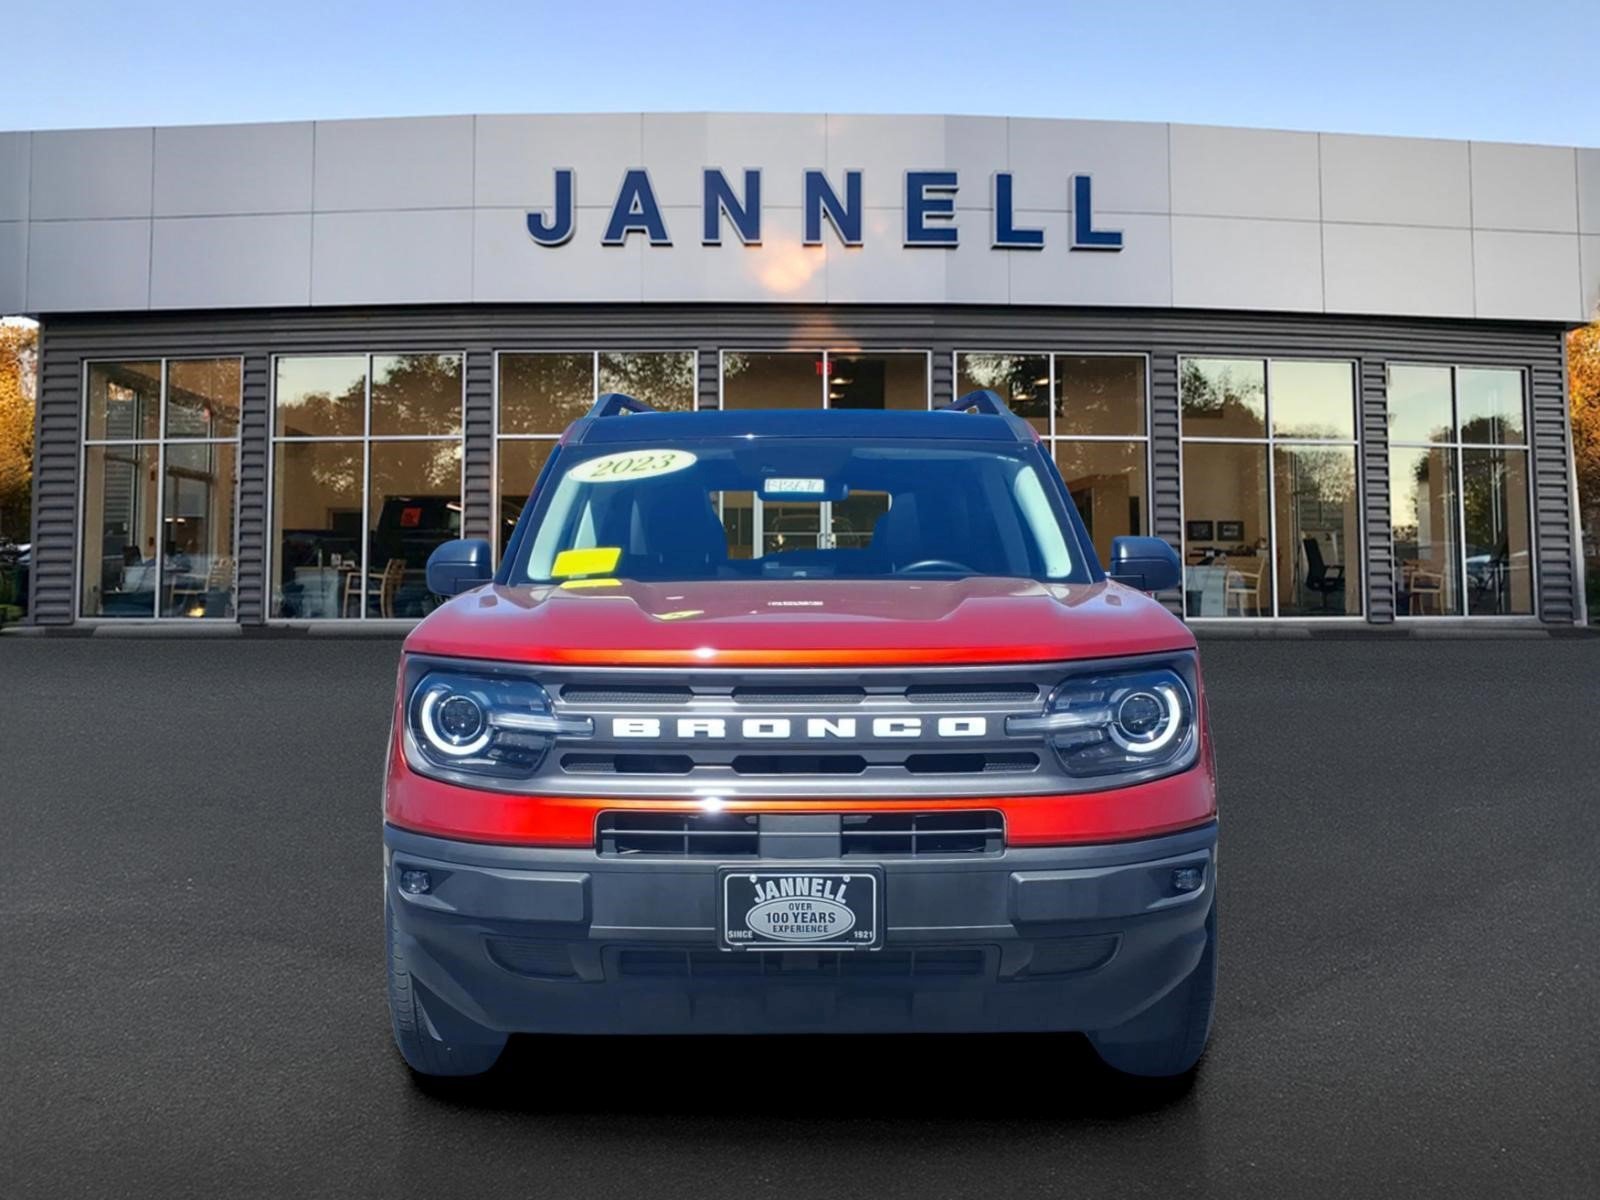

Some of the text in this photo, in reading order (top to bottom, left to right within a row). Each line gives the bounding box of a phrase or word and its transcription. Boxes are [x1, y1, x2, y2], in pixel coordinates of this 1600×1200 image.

[526, 167, 1123, 249] JANNELL
[591, 454, 677, 477] 2023
[612, 717, 987, 738] BRONCO
[754, 877, 847, 903] JANNELL
[788, 903, 813, 911] OVER
[766, 912, 836, 924] 100 YEARS
[728, 930, 753, 938] SINCE
[772, 925, 829, 933] EXPERIENCE
